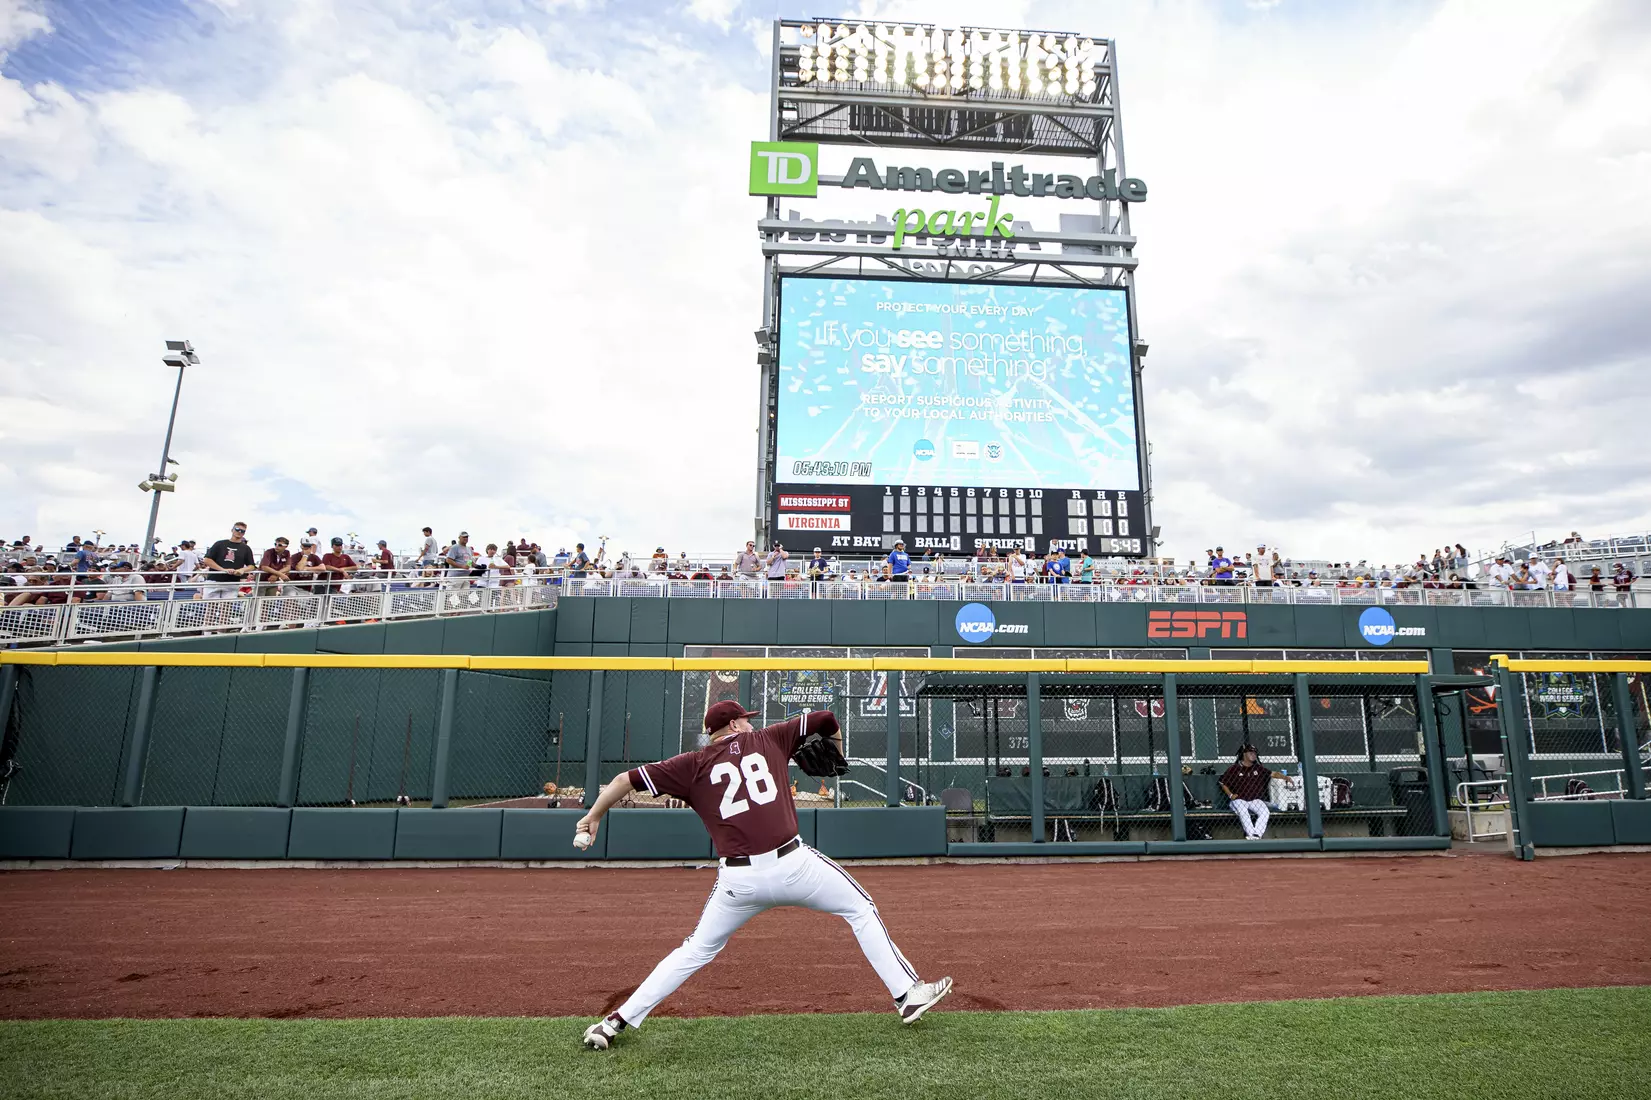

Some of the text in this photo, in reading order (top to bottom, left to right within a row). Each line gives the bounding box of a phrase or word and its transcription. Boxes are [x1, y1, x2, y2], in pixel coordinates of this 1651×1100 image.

[757, 151, 1148, 202] TD Ameritrade
[892, 195, 1015, 250] park
[876, 302, 1035, 316] PROTECT YOUR EVERY DAY
[842, 326, 891, 351] you
[897, 329, 944, 349] see
[949, 328, 1087, 357] something,
[861, 352, 1047, 381] say something
[862, 394, 914, 405] REPORT
[917, 395, 992, 408] SUSPICIOUS
[863, 408, 1053, 423] TO YOUR LOCAL AUTHORITIES
[793, 461, 872, 477] 05:43:10 PM
[885, 486, 1126, 500] 1 2 3 4 5 6 7 8 9 10 R H E
[780, 497, 849, 508] MISSISSIPPI ST
[1077, 500, 1127, 516] 0 0 0
[788, 517, 840, 529] VIRGINIA
[1079, 518, 1128, 536] 0 0 0
[832, 536, 850, 547] AT
[853, 536, 881, 547] BAT
[915, 537, 949, 548] BALL
[1110, 538, 1140, 554] 5:43
[960, 622, 1028, 633] NCAA.com
[1148, 611, 1247, 638] ESPN
[1363, 625, 1425, 636] NCAA.com
[792, 686, 823, 695] COLLEGE
[1547, 687, 1573, 695] COLLEGE
[781, 694, 833, 703] WORLD SERIES
[1008, 736, 1029, 749] 375
[1267, 735, 1287, 748] 375
[709, 752, 778, 819] 28
